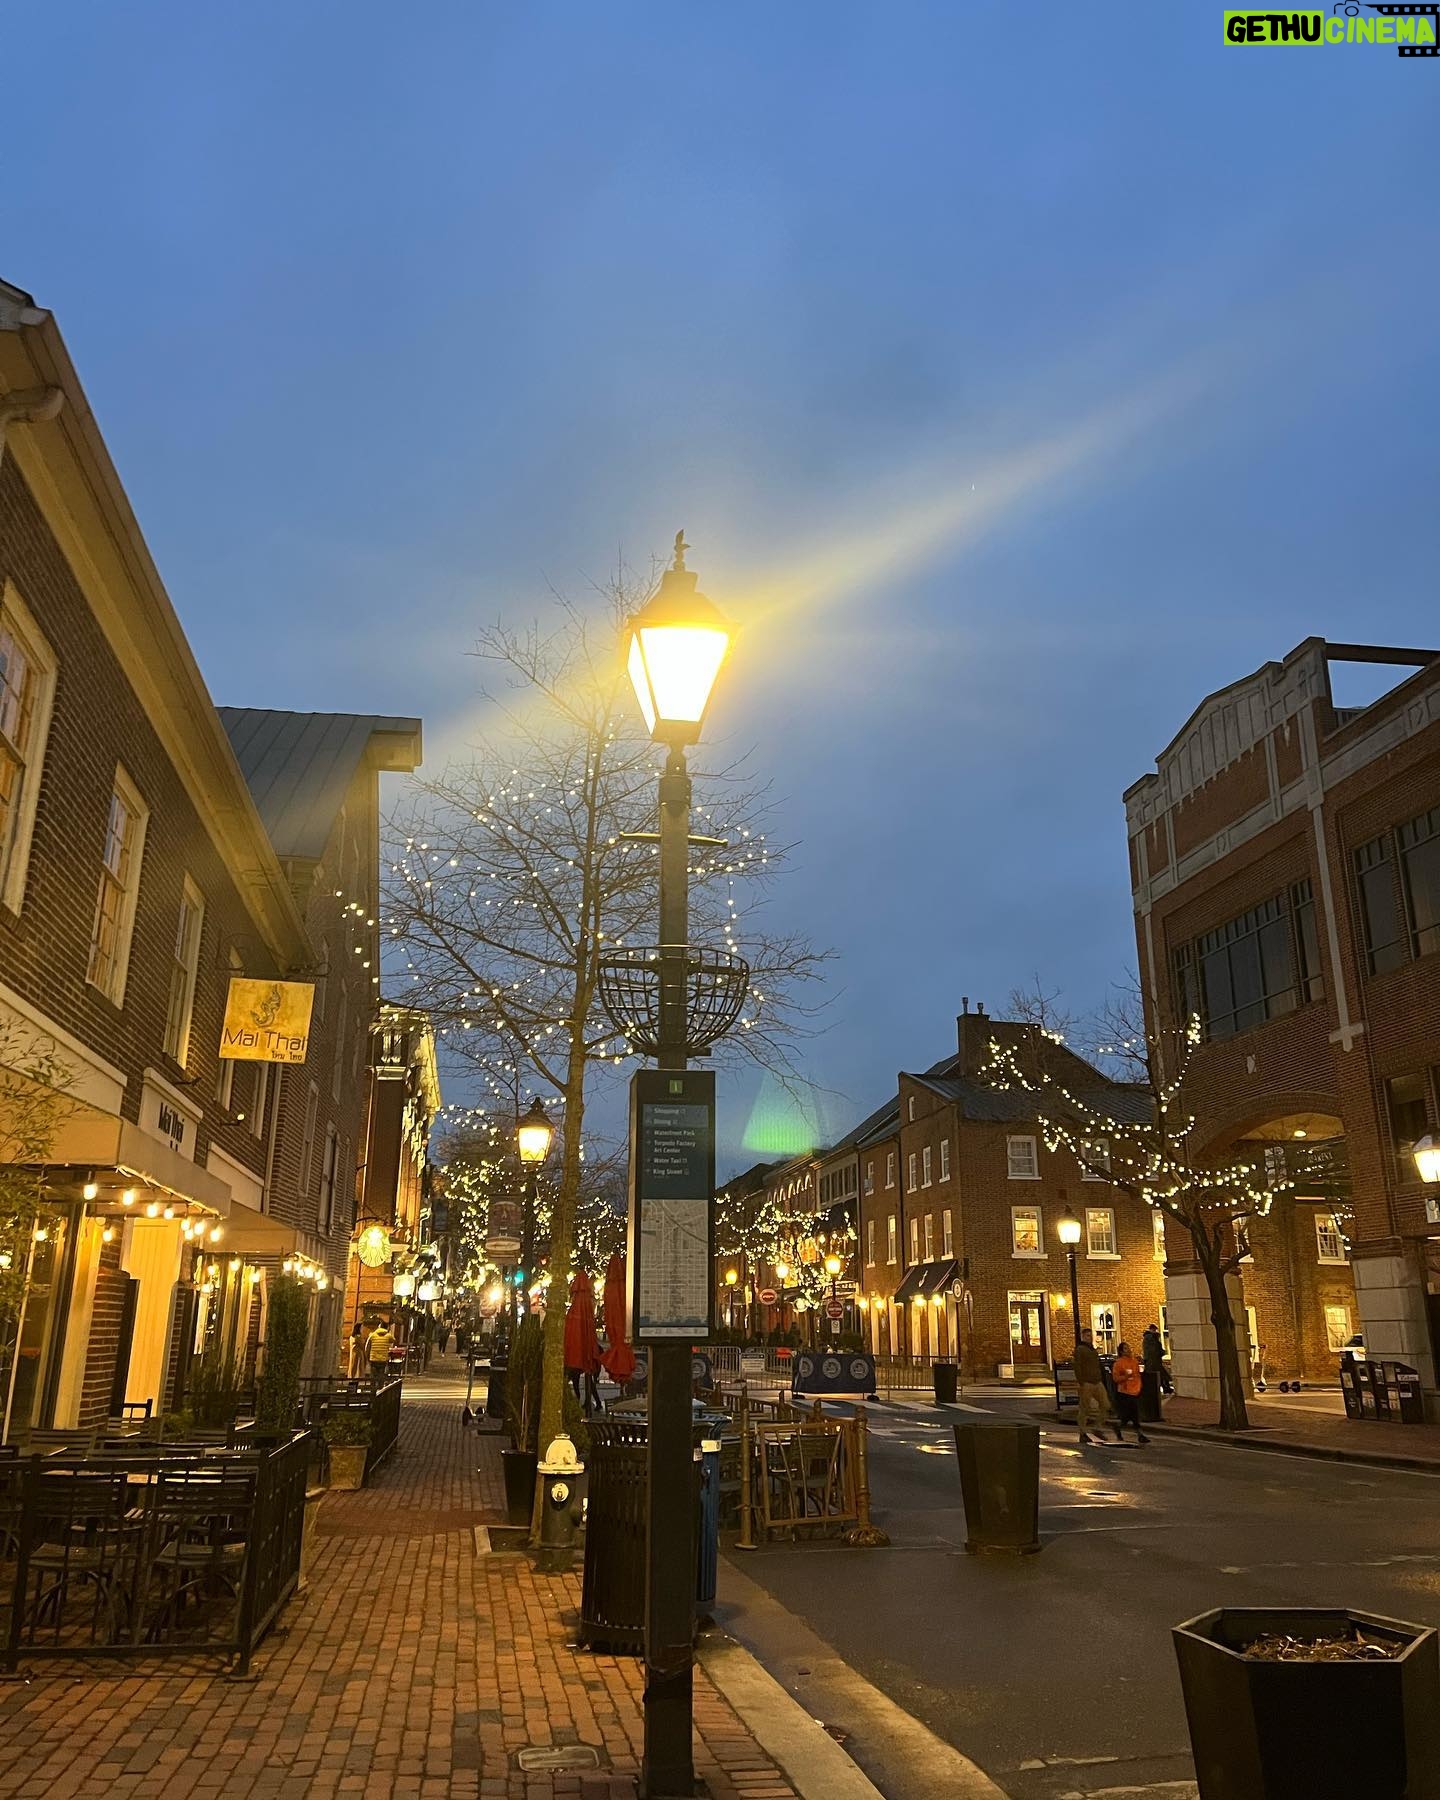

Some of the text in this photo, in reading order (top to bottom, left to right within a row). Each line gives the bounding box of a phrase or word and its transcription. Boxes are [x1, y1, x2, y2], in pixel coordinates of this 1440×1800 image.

[223, 1027, 306, 1052] Mai Thai
[676, 1140, 697, 1148] Factory
[653, 1168, 666, 1176] King
